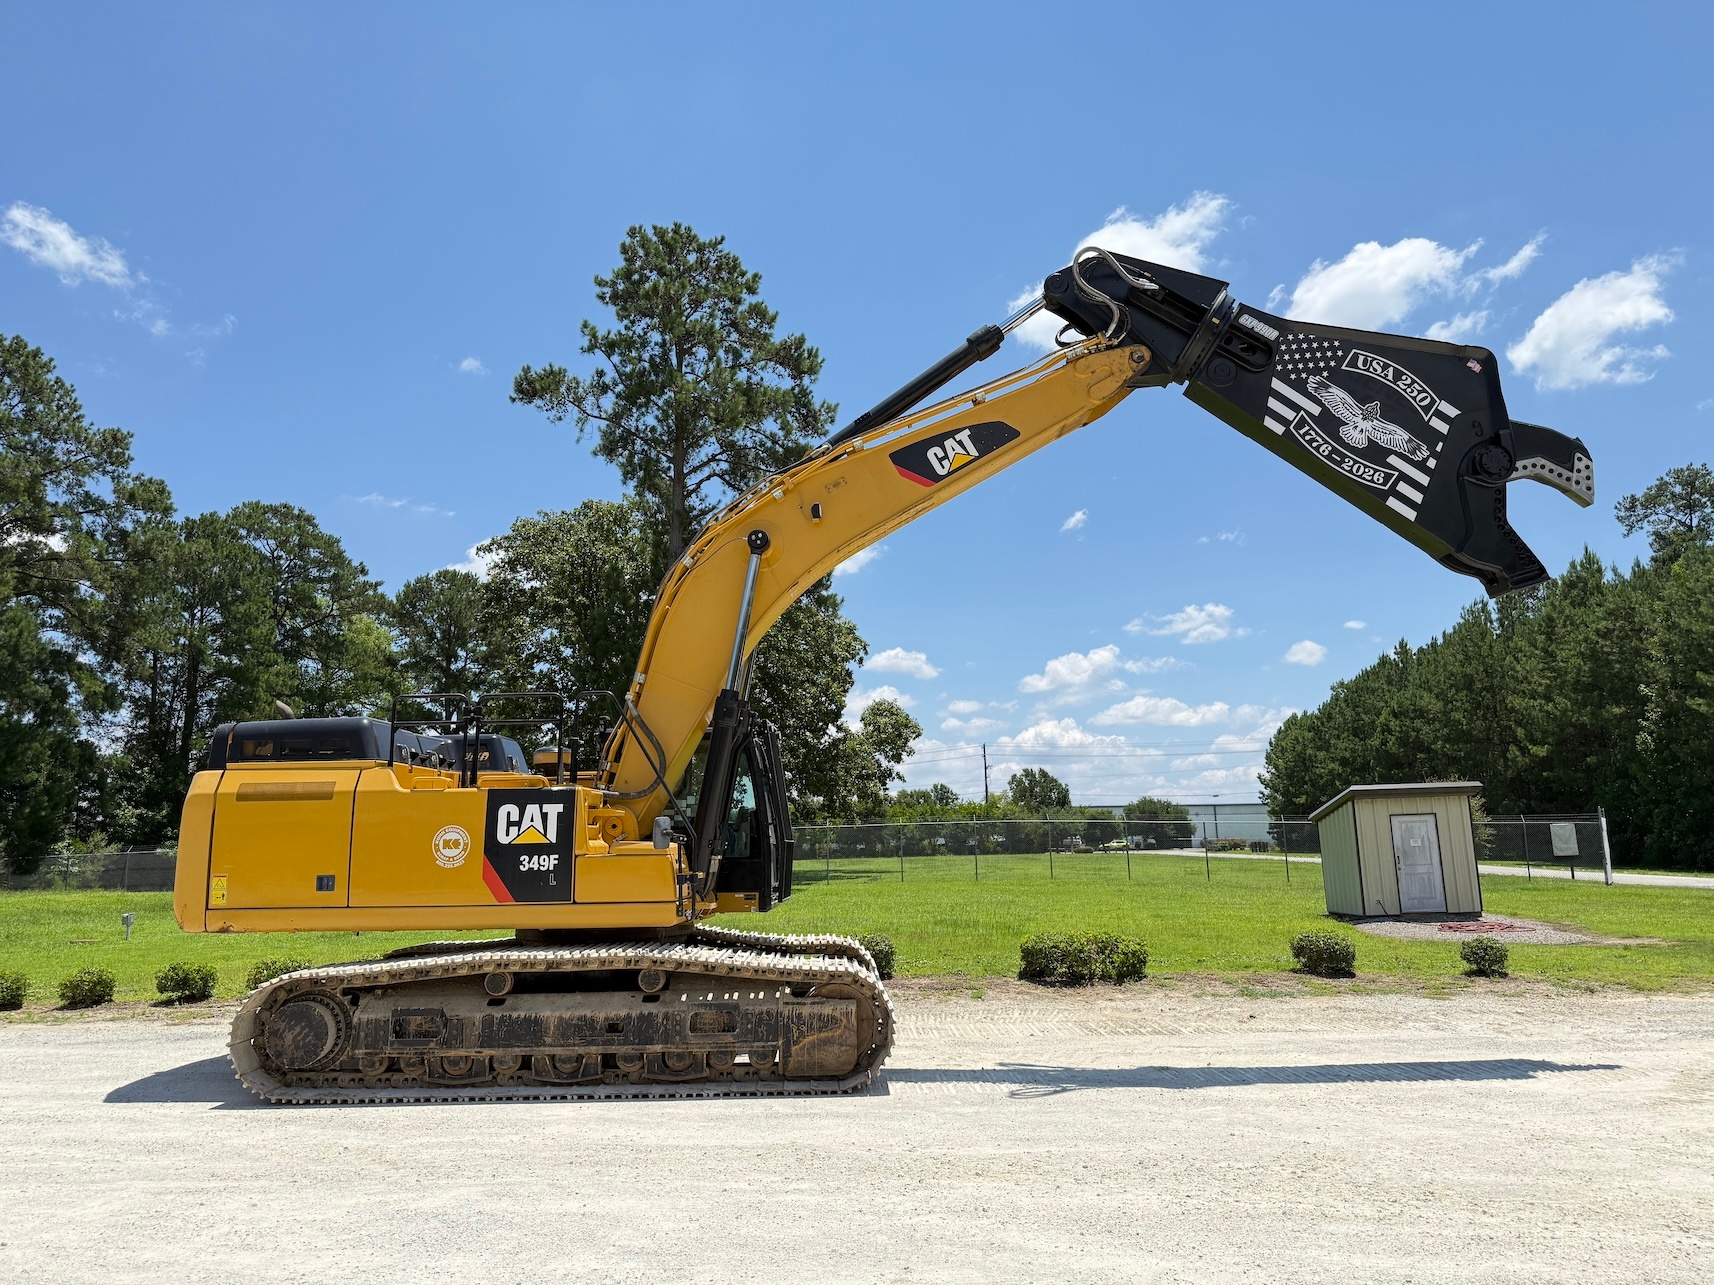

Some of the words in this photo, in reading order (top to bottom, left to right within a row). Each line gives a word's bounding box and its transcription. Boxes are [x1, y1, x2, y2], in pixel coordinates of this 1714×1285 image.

[1356, 354, 1394, 381] USA
[1396, 374, 1431, 406] 250
[926, 428, 979, 476] CAT
[1297, 423, 1332, 456] 1776
[1340, 457, 1385, 484] 2026
[496, 803, 564, 845] CAT
[519, 854, 559, 872] 349F
[549, 873, 557, 886] L
